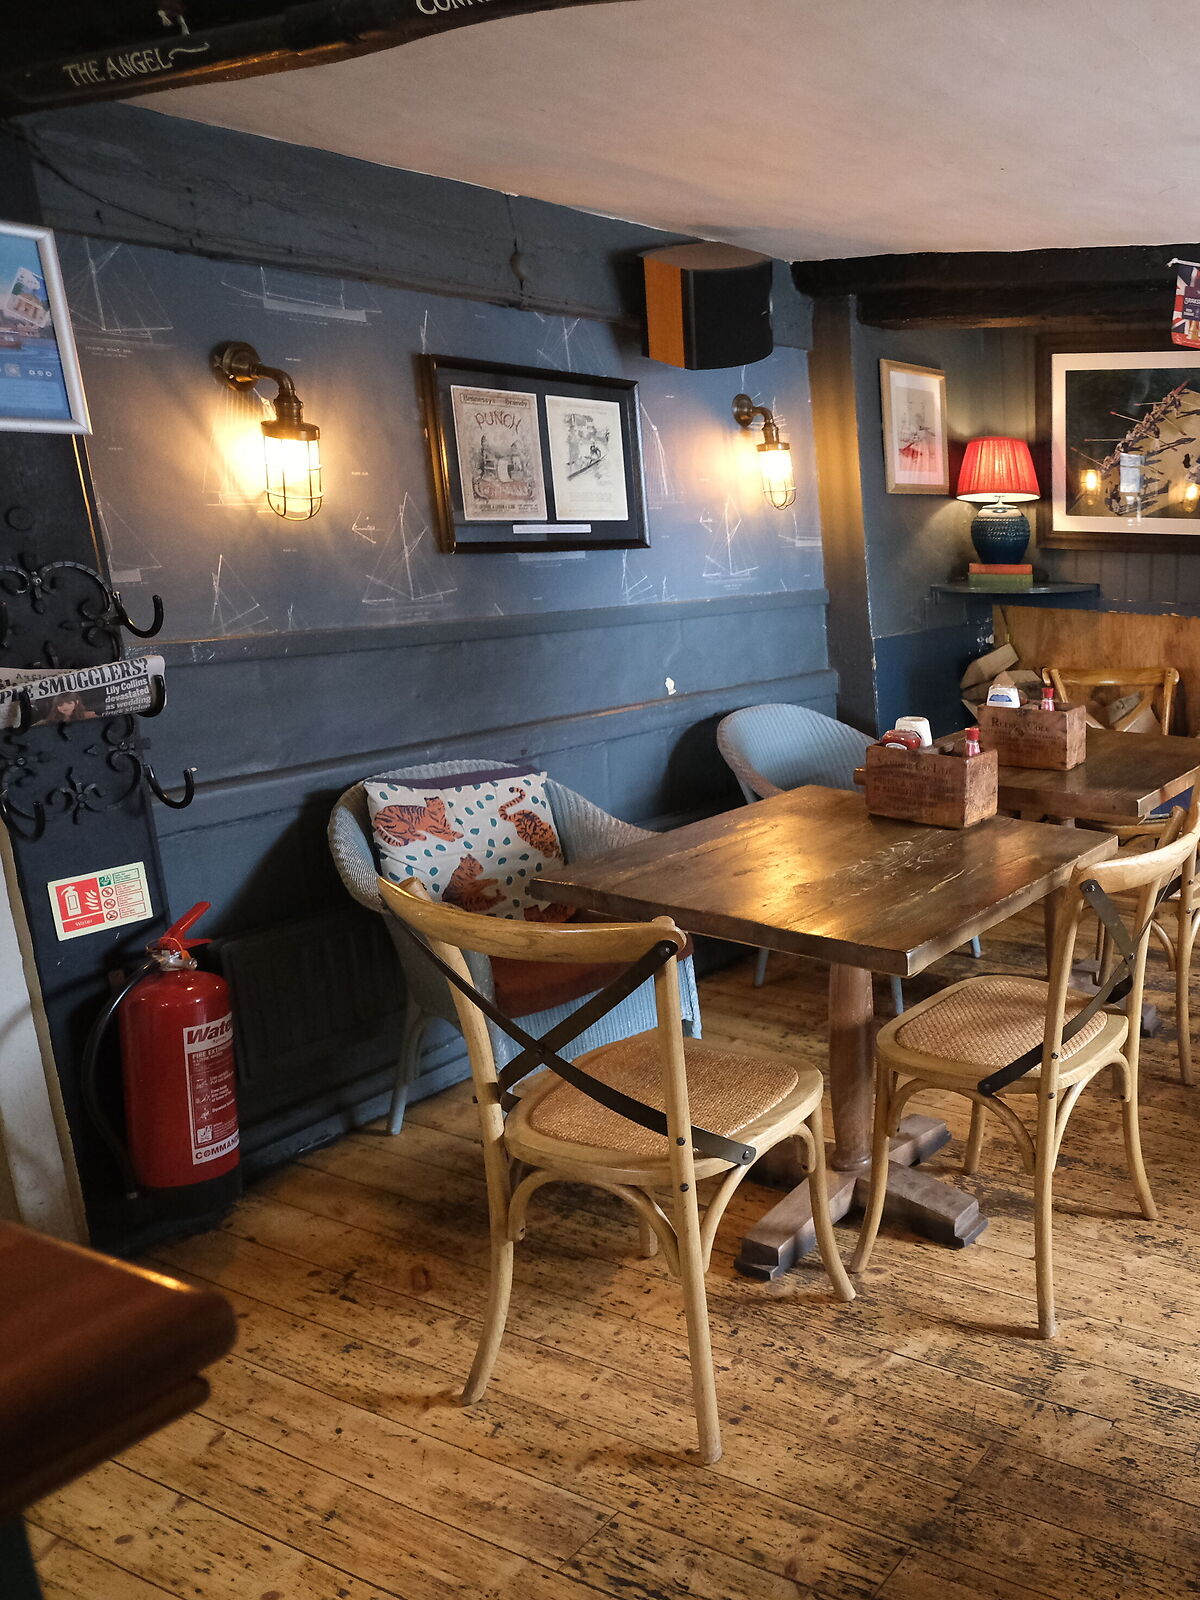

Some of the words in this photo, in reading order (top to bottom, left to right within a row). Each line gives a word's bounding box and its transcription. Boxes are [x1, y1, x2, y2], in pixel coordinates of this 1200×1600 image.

[62, 60, 106, 86] THE
[106, 48, 173, 80] ANGEL
[475, 410, 522, 434] PUNCH
[38, 657, 149, 696] SMUGGLERS?
[106, 685, 120, 695] Lily
[121, 678, 148, 691] Collins
[105, 686, 150, 703] devastated
[105, 703, 116, 711] as
[116, 696, 152, 709] wedding
[187, 1020, 232, 1045] Wate
